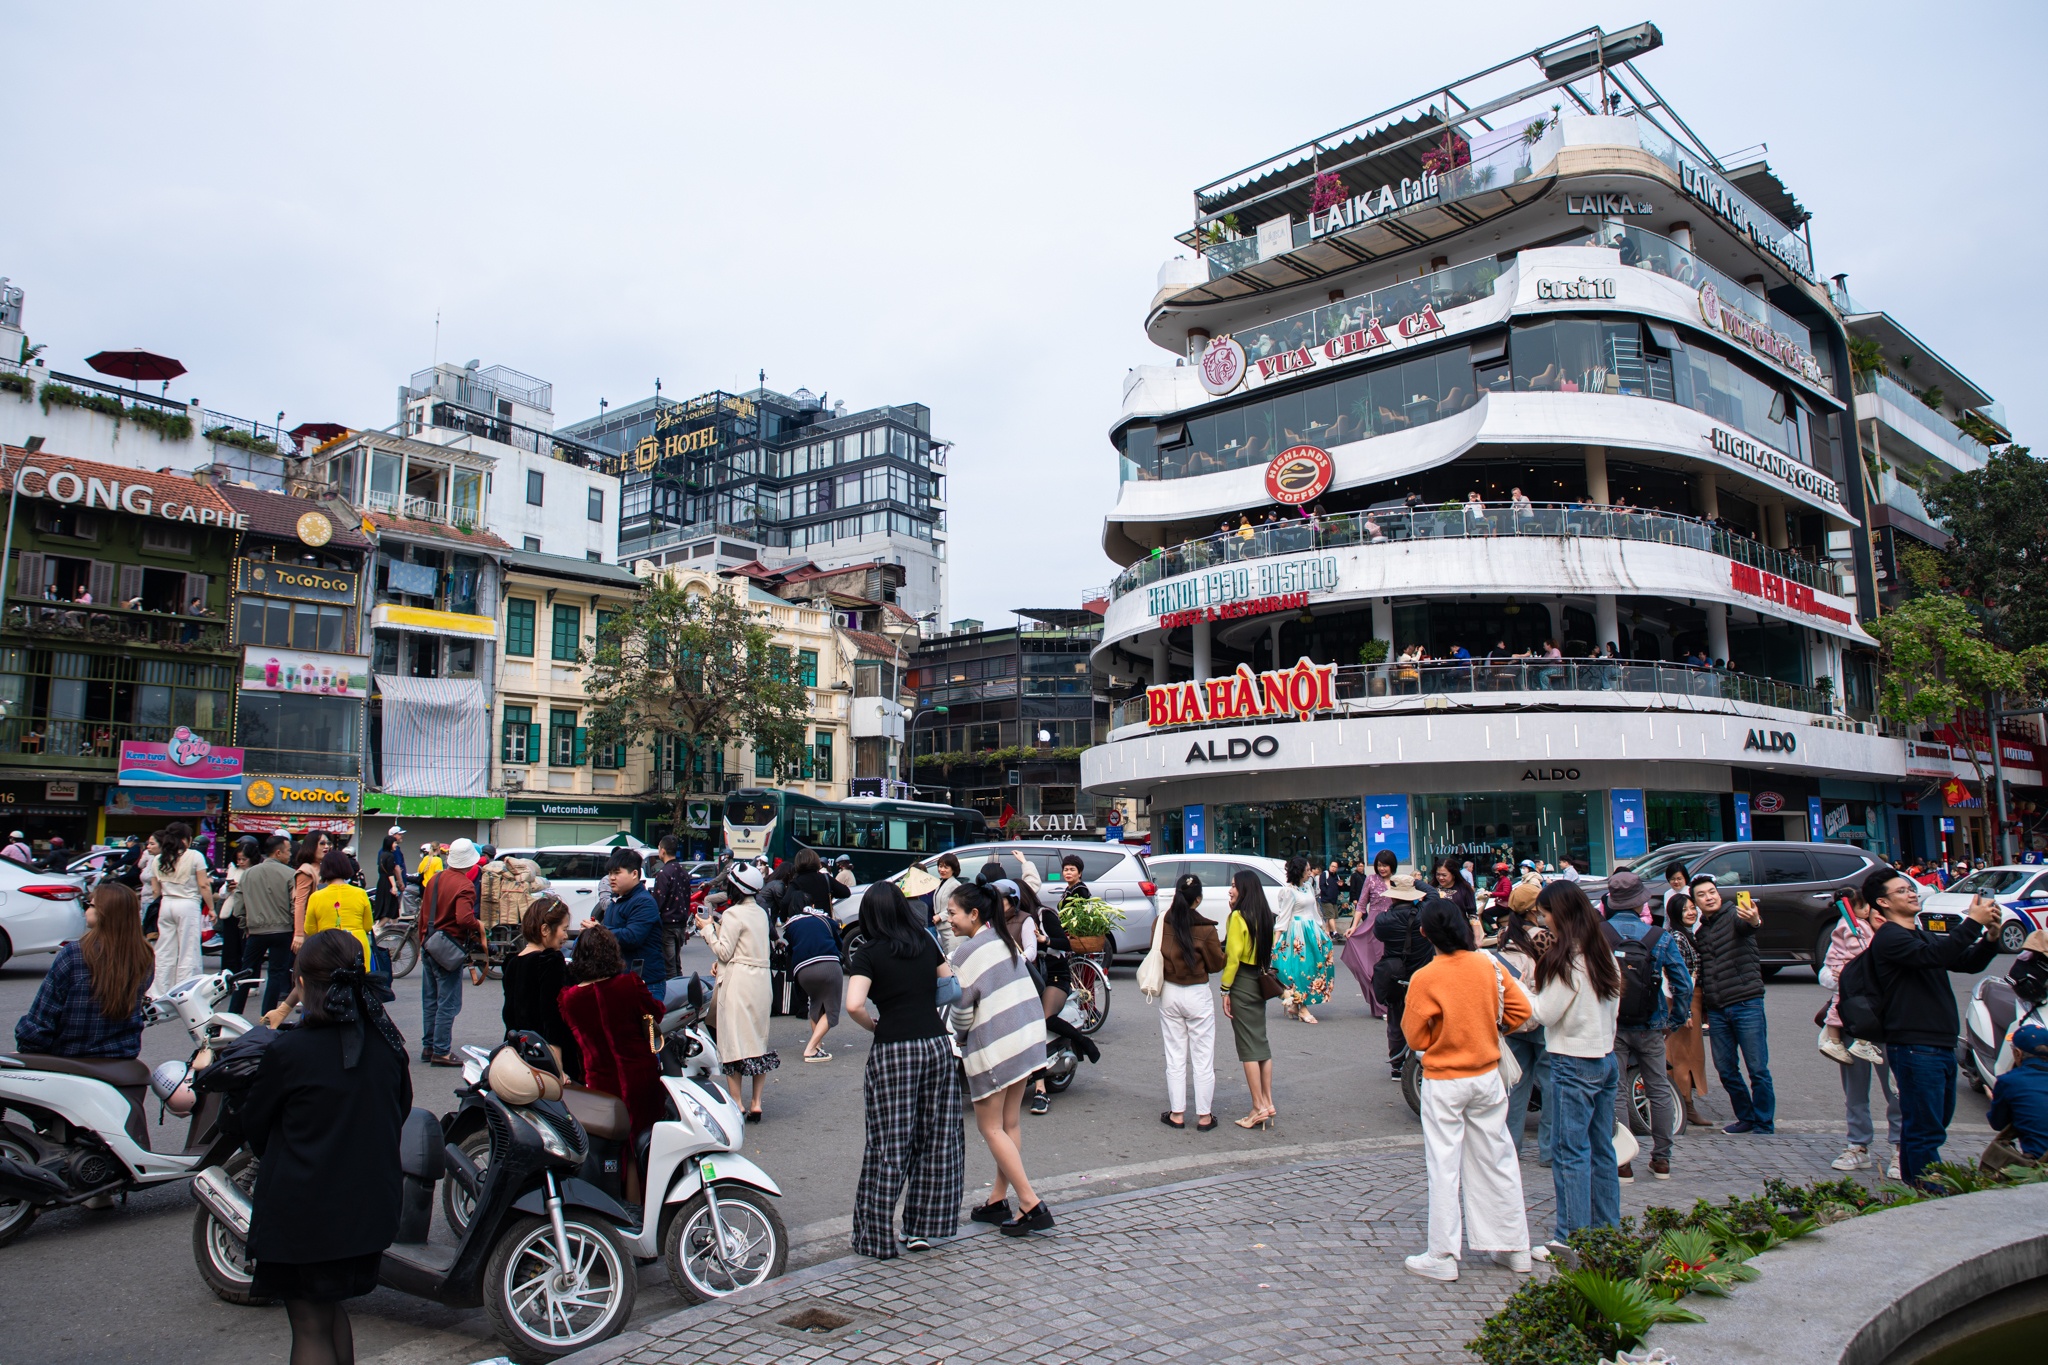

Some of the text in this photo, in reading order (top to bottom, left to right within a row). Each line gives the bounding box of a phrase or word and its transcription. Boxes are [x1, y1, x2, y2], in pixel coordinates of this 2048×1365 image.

[1308, 170, 1440, 240] LAIKA Café
[1566, 192, 1636, 215] LAIKA
[1680, 160, 1731, 223] LAIKA
[1749, 221, 1769, 249] The
[1537, 274, 1616, 300] Cơ sở 10
[1720, 308, 1752, 347] VUA
[1255, 302, 1446, 381] VUA CHẢ CÁ
[669, 416, 683, 427] SKY
[684, 406, 716, 421] LOUNGE
[664, 425, 719, 460] HOTEL
[1267, 448, 1328, 479] HIGHLANDS
[1711, 428, 1840, 504] HIGHLANDS COFFEE
[1276, 481, 1324, 502] COFFEE
[1147, 556, 1338, 617] HANOI 1930 BISTRO
[1159, 591, 1310, 630] COFFEE & RESTAURANT
[1147, 658, 1335, 727] BIA HÀ NỘI
[1184, 734, 1280, 764] ALDO
[1743, 728, 1797, 753] ALDO
[125, 751, 147, 761] Kem
[207, 755, 222, 765] Trà
[1520, 768, 1581, 782] ALDO
[541, 804, 599, 815] Vietcombank
[1028, 814, 1088, 832] KAFA
[1042, 833, 1073, 841] Café
[1461, 841, 1491, 854] Mình
